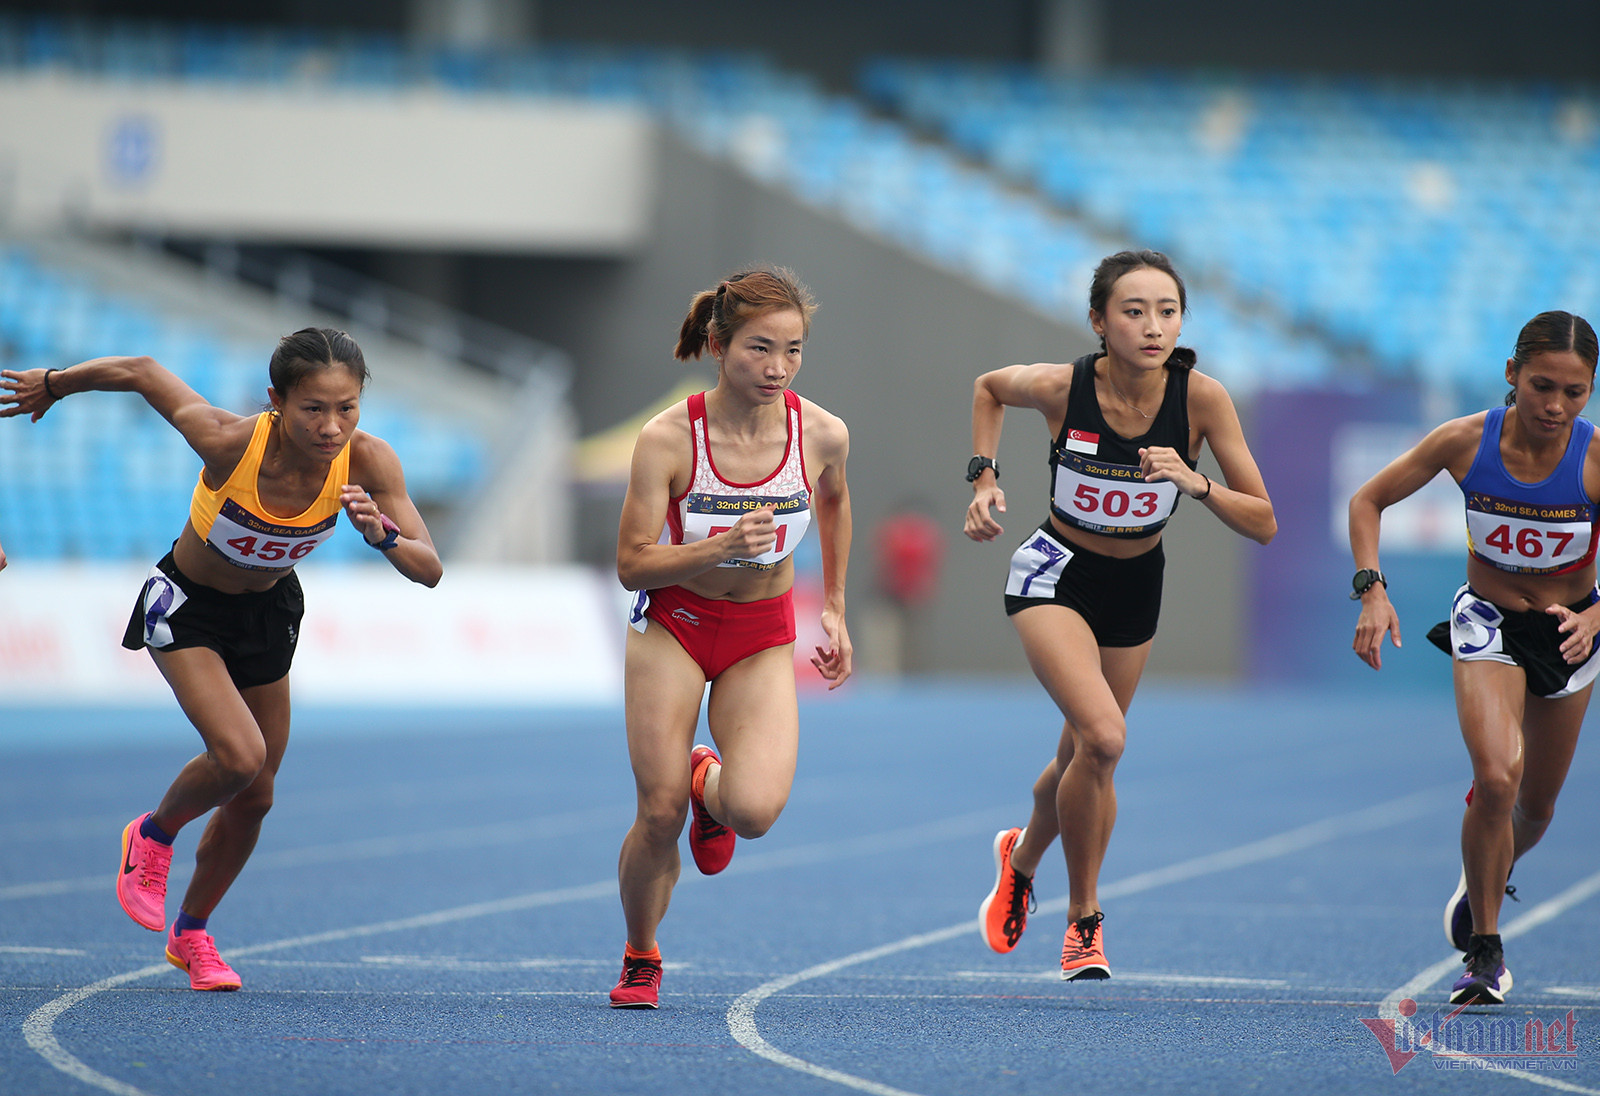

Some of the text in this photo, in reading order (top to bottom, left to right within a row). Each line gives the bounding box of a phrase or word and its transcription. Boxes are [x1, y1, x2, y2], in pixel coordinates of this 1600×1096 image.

[1085, 464, 1109, 476] 32nd
[1110, 470, 1131, 478] SEA
[716, 501, 740, 510] 32nd
[742, 501, 762, 510] SEA
[1072, 483, 1159, 518] 503
[1495, 502, 1577, 518] 32nd SEA GAMES
[247, 519, 327, 535] 32nd SEA GAMES
[226, 535, 318, 561] 456
[1485, 523, 1575, 558] 467
[1020, 536, 1067, 596] 7
